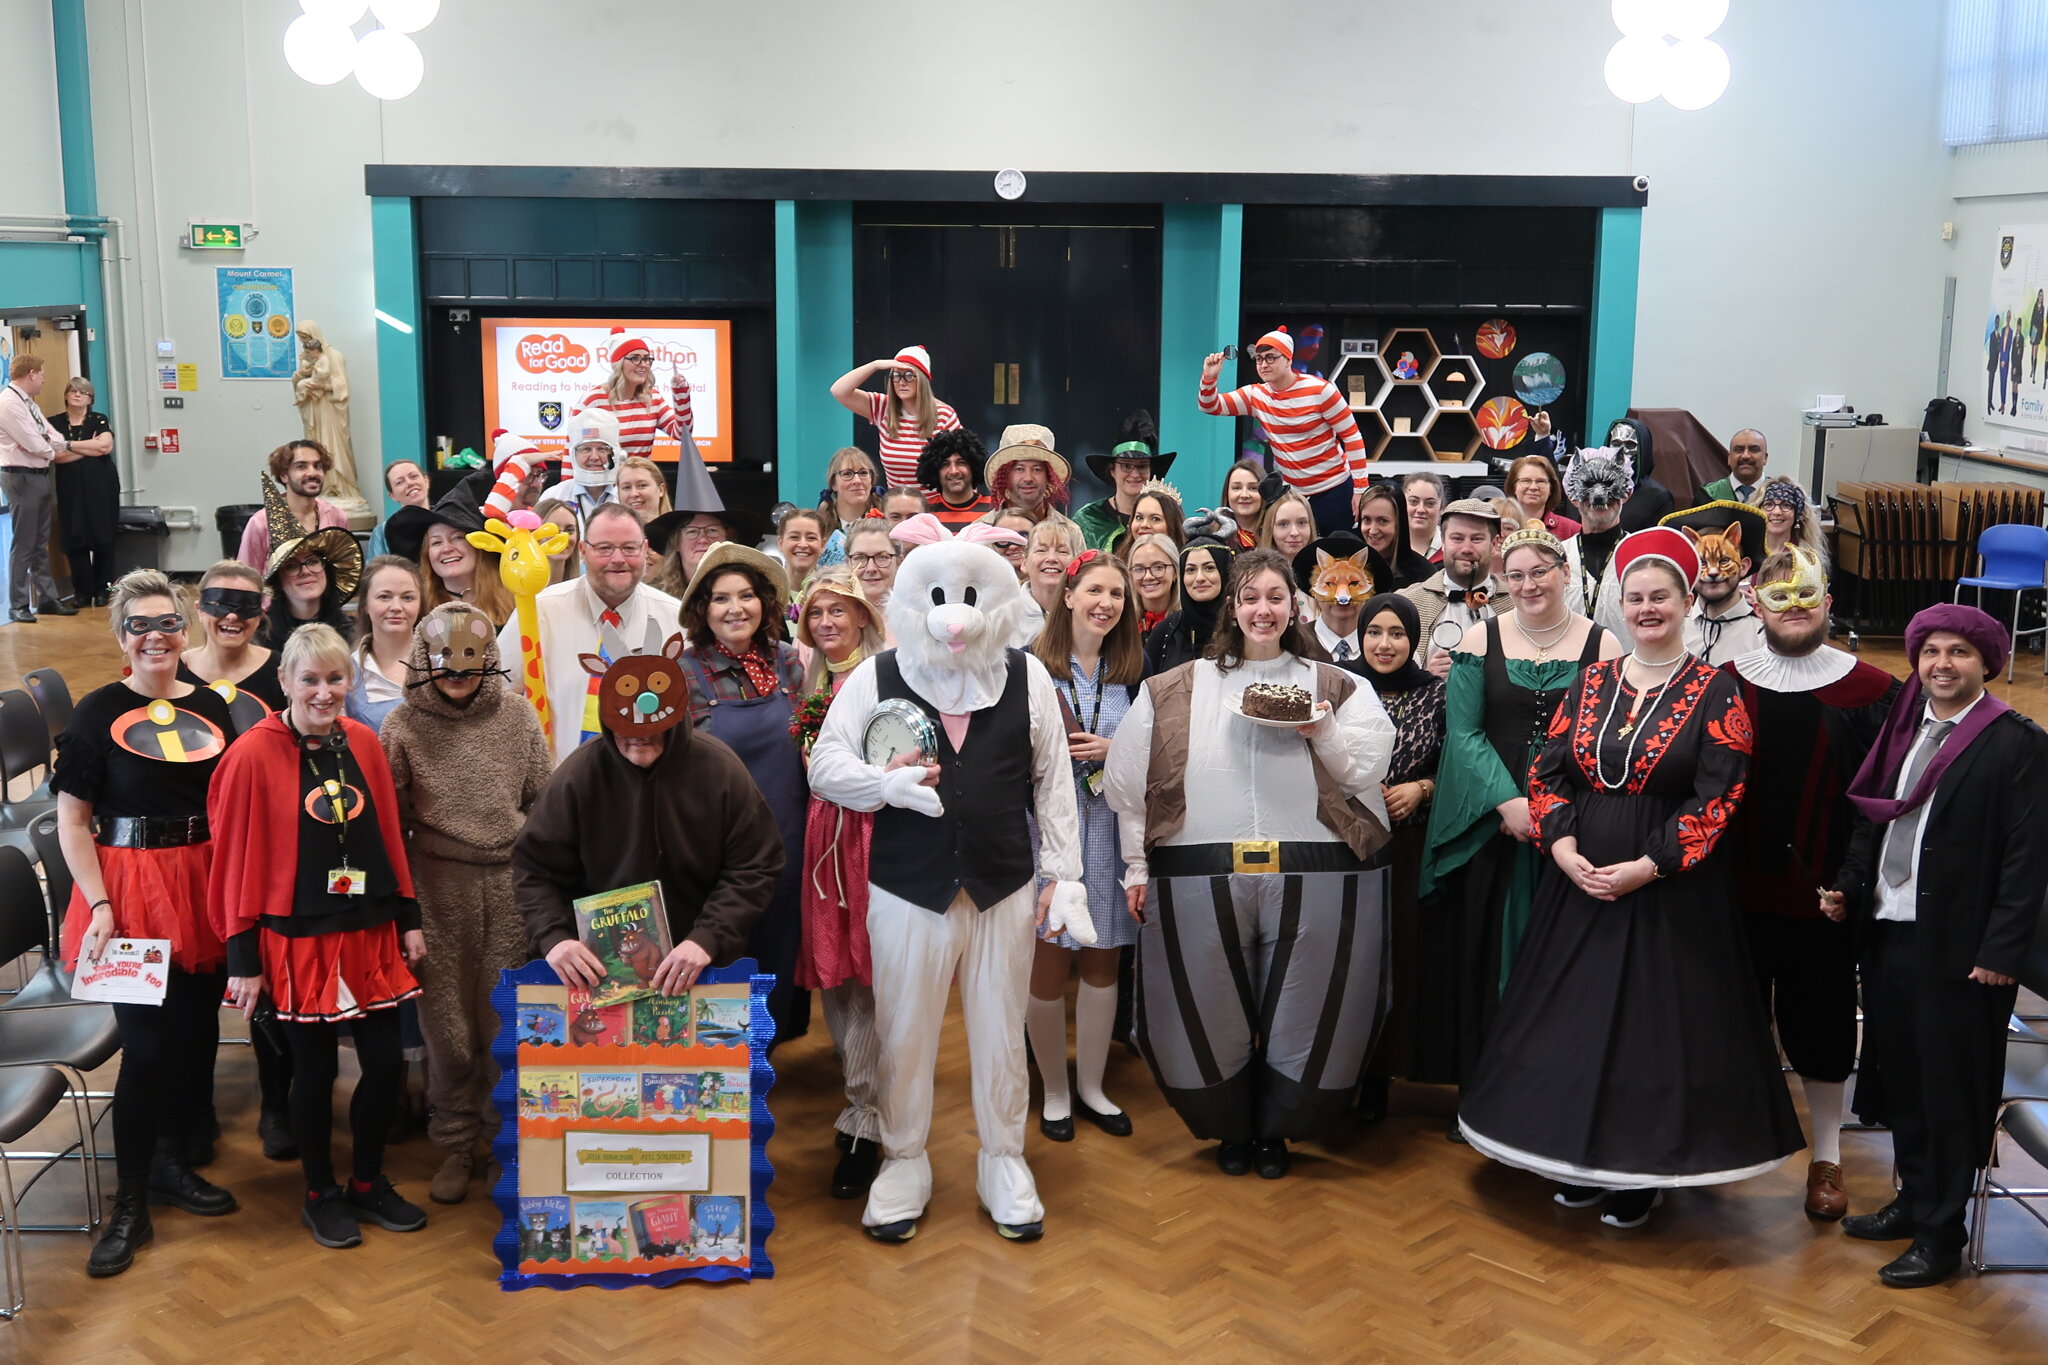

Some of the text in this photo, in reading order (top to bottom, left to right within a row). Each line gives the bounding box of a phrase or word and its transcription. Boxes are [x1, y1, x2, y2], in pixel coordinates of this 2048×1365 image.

[520, 336, 564, 358] Read
[528, 353, 588, 369] for Good
[596, 345, 697, 364] Rathon
[511, 381, 557, 393] Reading
[560, 381, 571, 391] to
[2021, 398, 2044, 415] Family
[590, 907, 649, 930] GRUFFALO
[81, 967, 162, 988] Incredible too
[647, 997, 680, 1007] Monkey
[652, 1006, 676, 1016] Puzzle
[586, 1076, 632, 1084] SUPERWORM
[605, 1172, 663, 1181] COLLECTION
[704, 1204, 732, 1214] STICK
[650, 1212, 678, 1227] GIANT
[707, 1214, 727, 1222] MAN
